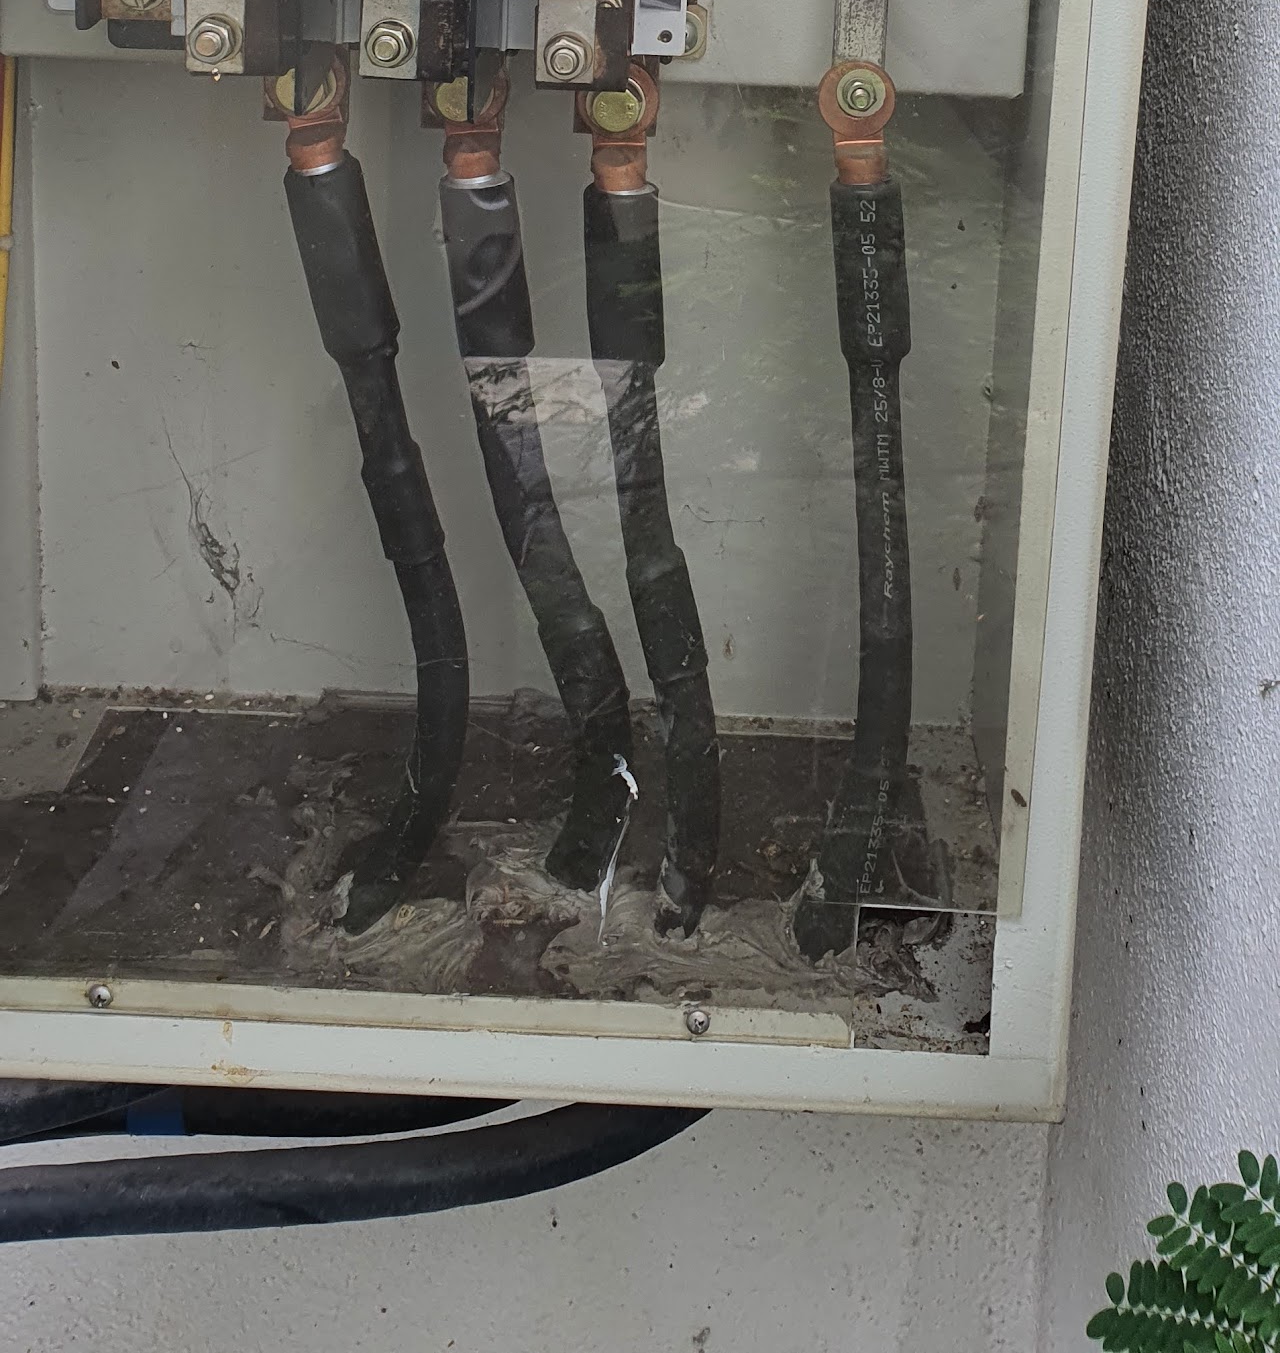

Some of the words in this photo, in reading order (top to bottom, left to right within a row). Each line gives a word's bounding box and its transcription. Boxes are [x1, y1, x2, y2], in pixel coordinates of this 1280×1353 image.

[860, 200, 876, 223] 52
[877, 434, 891, 481] MWTM
[882, 492, 894, 599] Raychem
